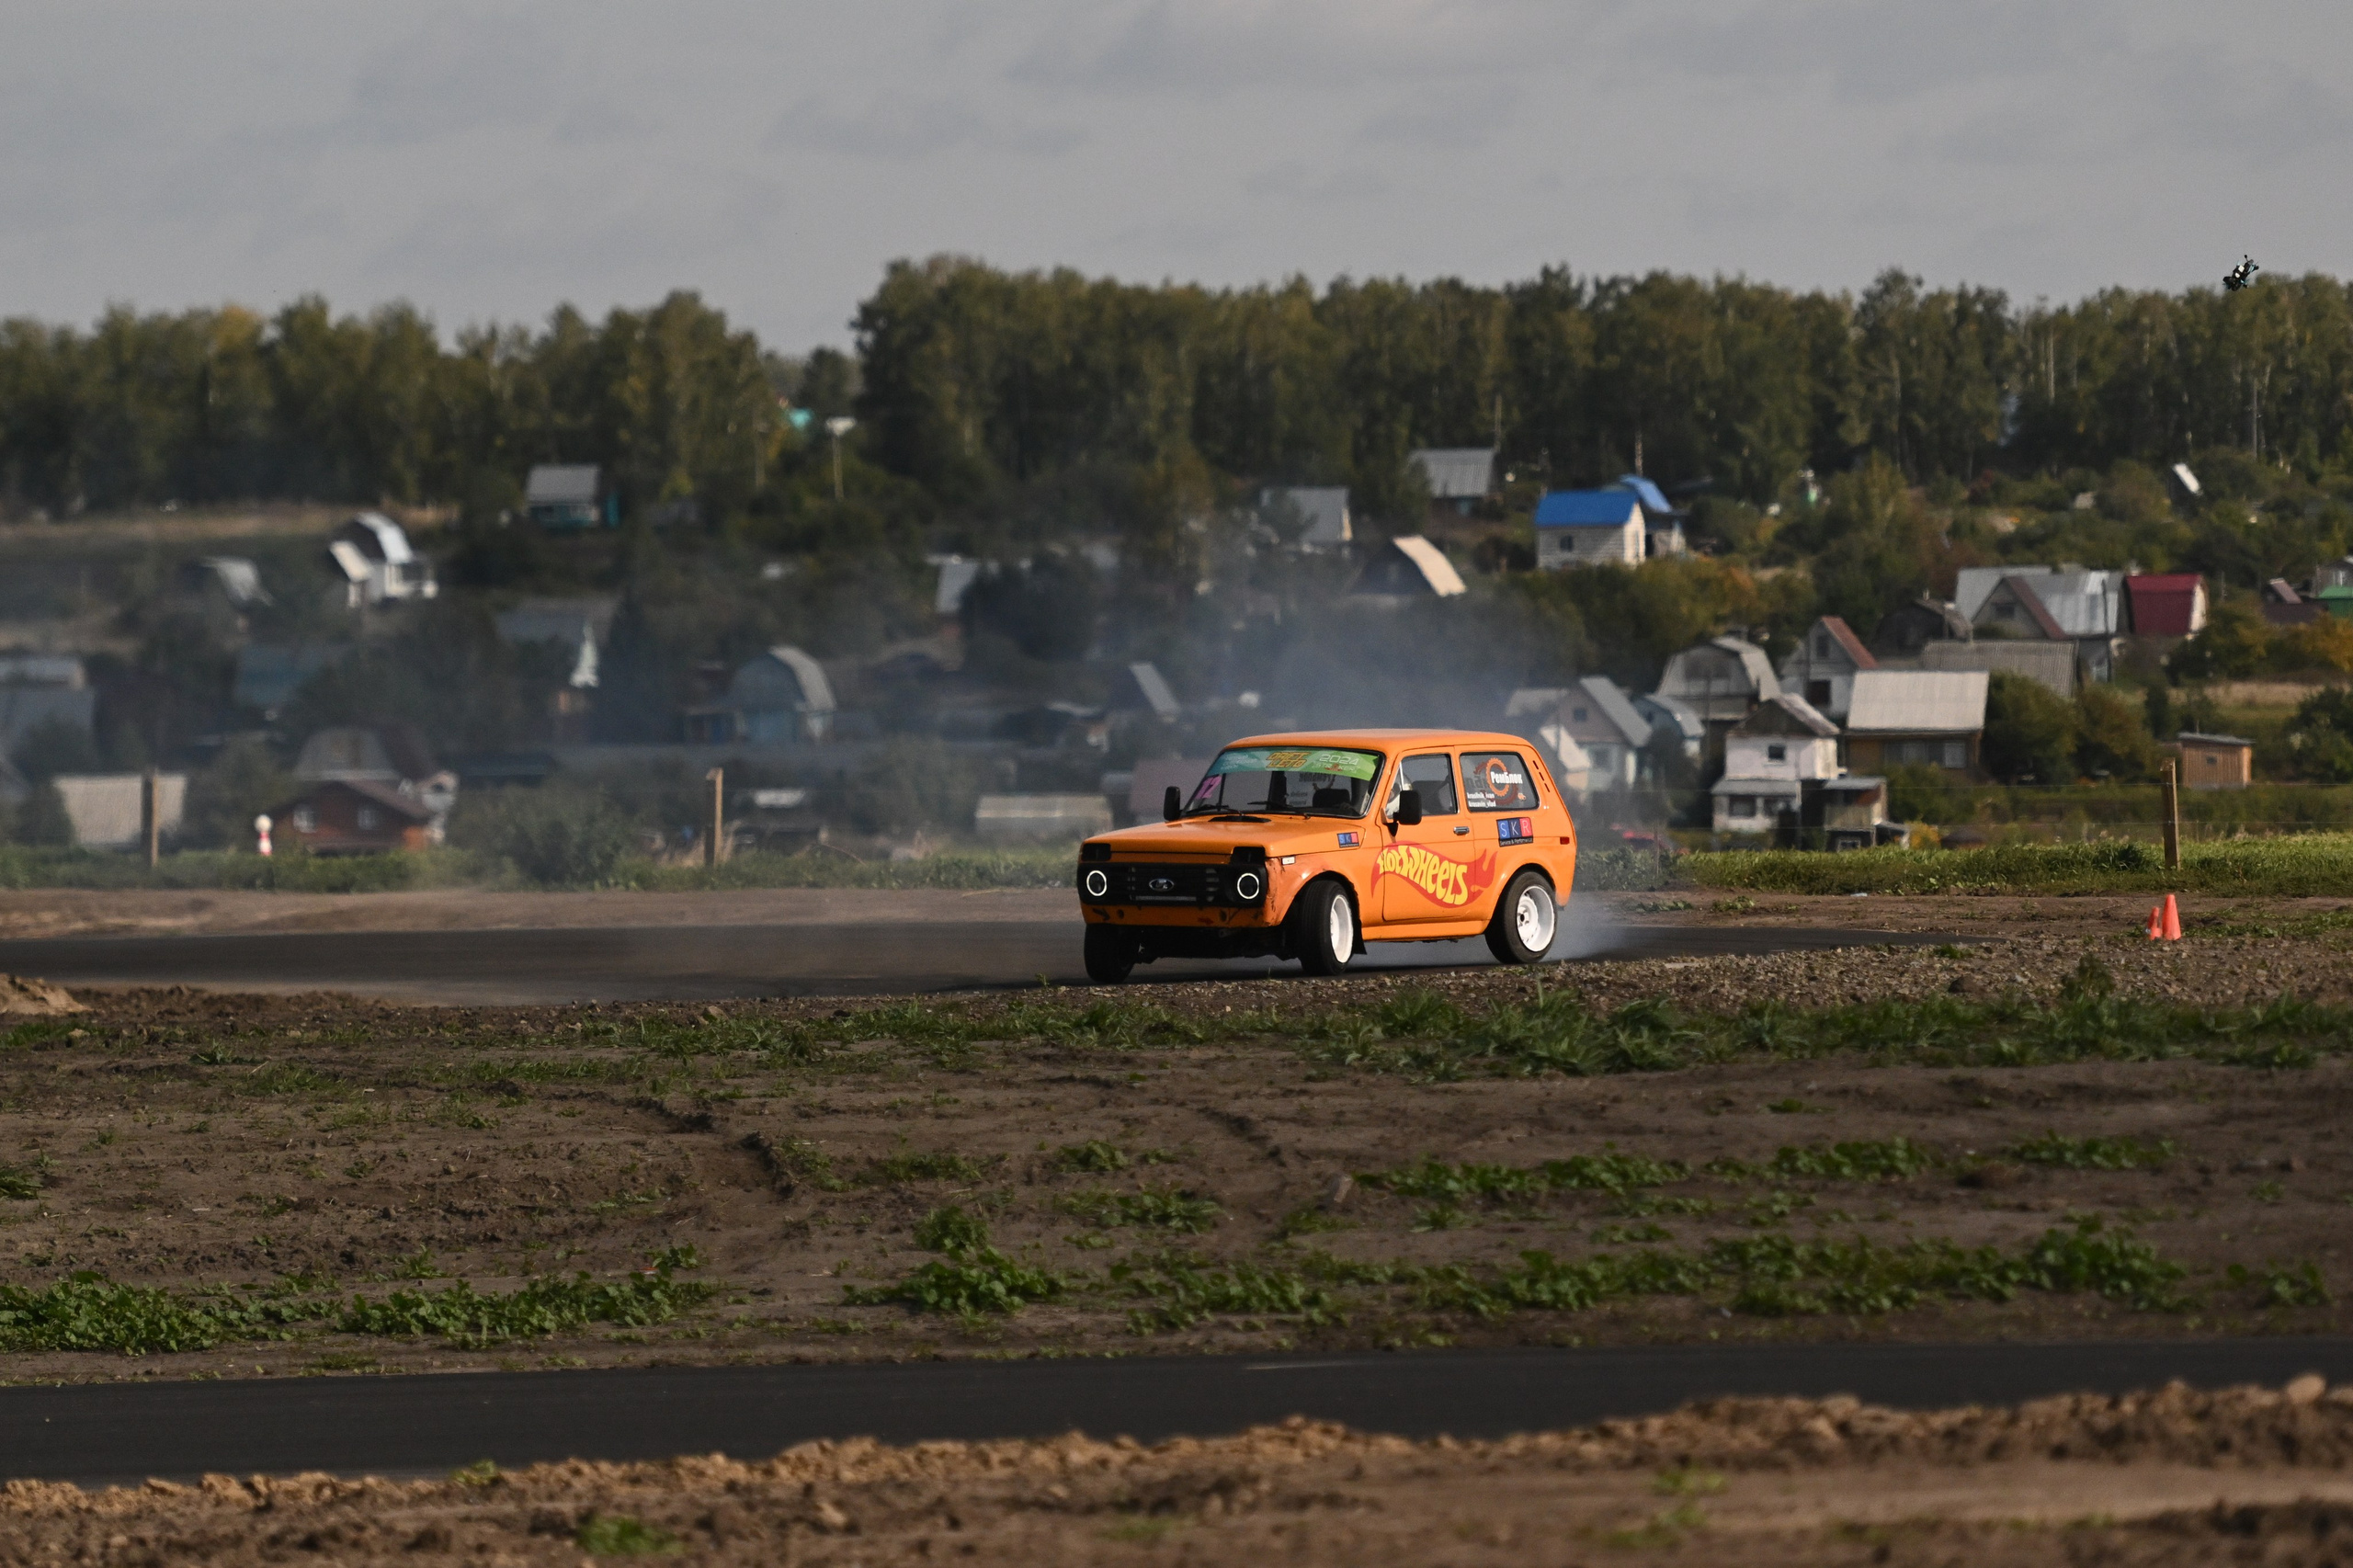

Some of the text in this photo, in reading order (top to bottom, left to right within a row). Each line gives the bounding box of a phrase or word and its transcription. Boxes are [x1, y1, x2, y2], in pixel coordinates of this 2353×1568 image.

[1266, 759, 1308, 768] LETO
[1319, 754, 1359, 766] 2024
[1500, 820, 1530, 837] SKR
